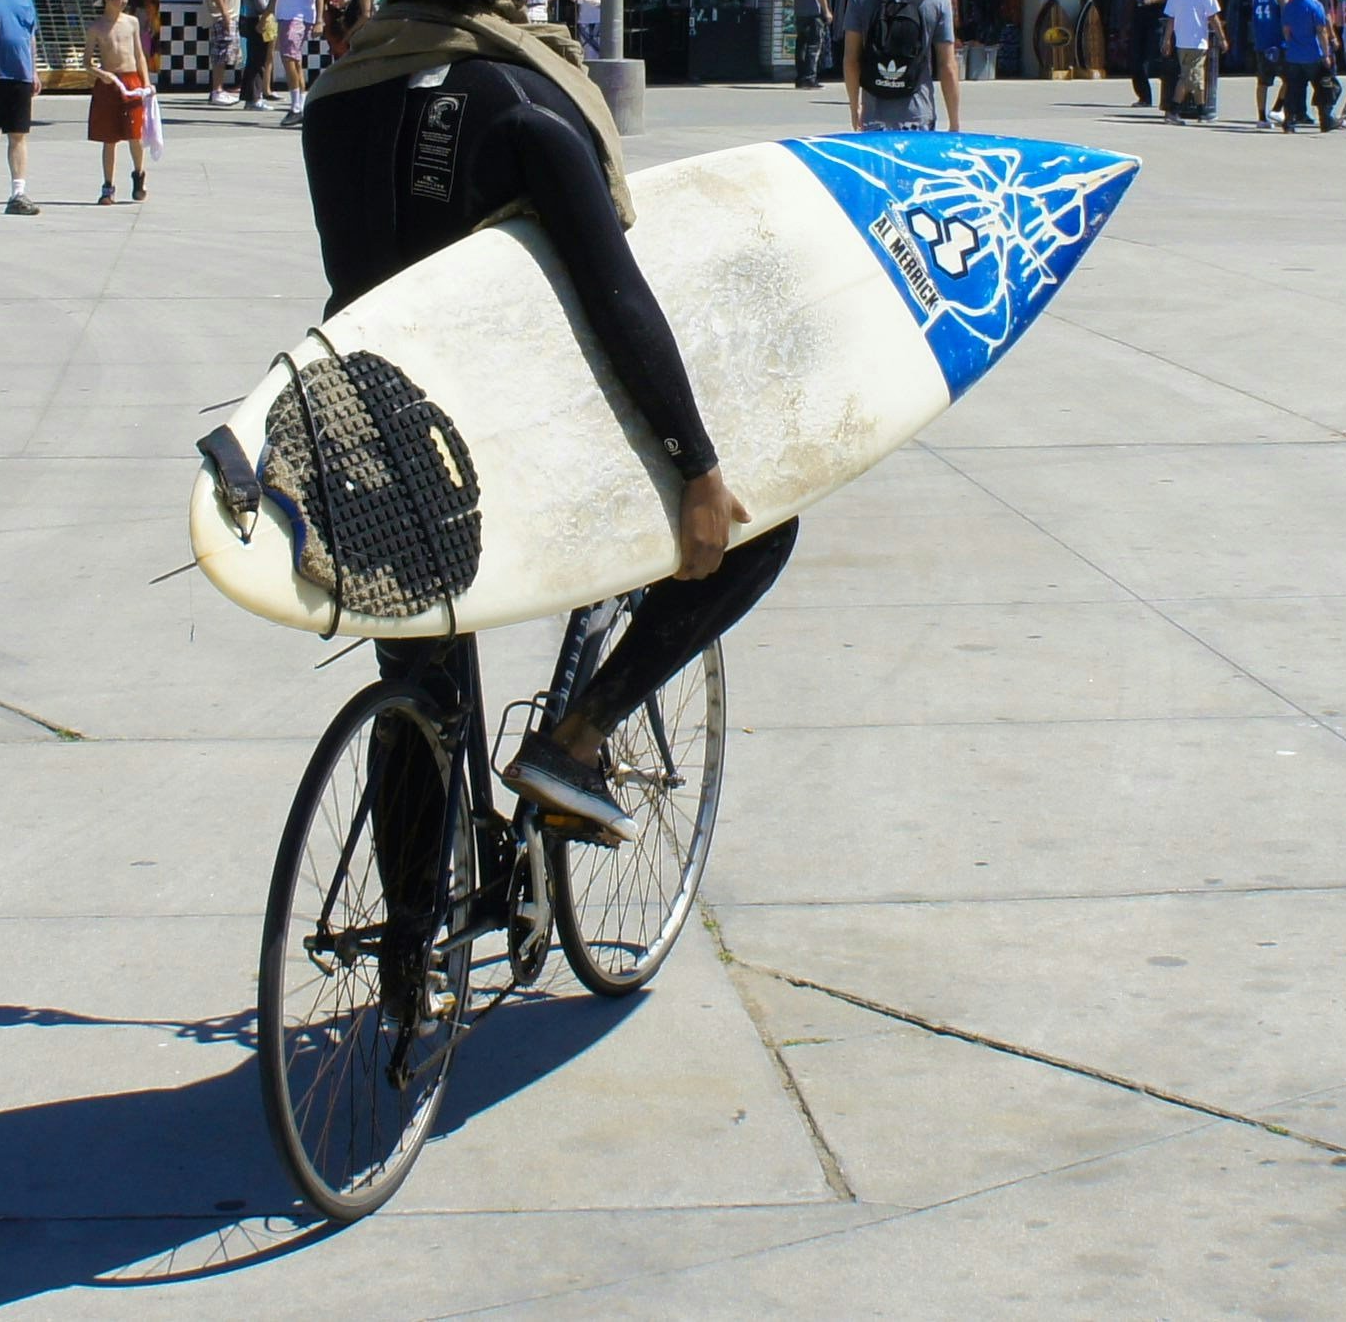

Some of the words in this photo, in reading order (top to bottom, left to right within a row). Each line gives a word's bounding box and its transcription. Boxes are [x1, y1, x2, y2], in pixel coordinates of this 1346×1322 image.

[1255, 5, 1271, 19] 44
[875, 79, 905, 88] adidas
[874, 216, 893, 241] AL
[889, 237, 939, 311] MERRICK
